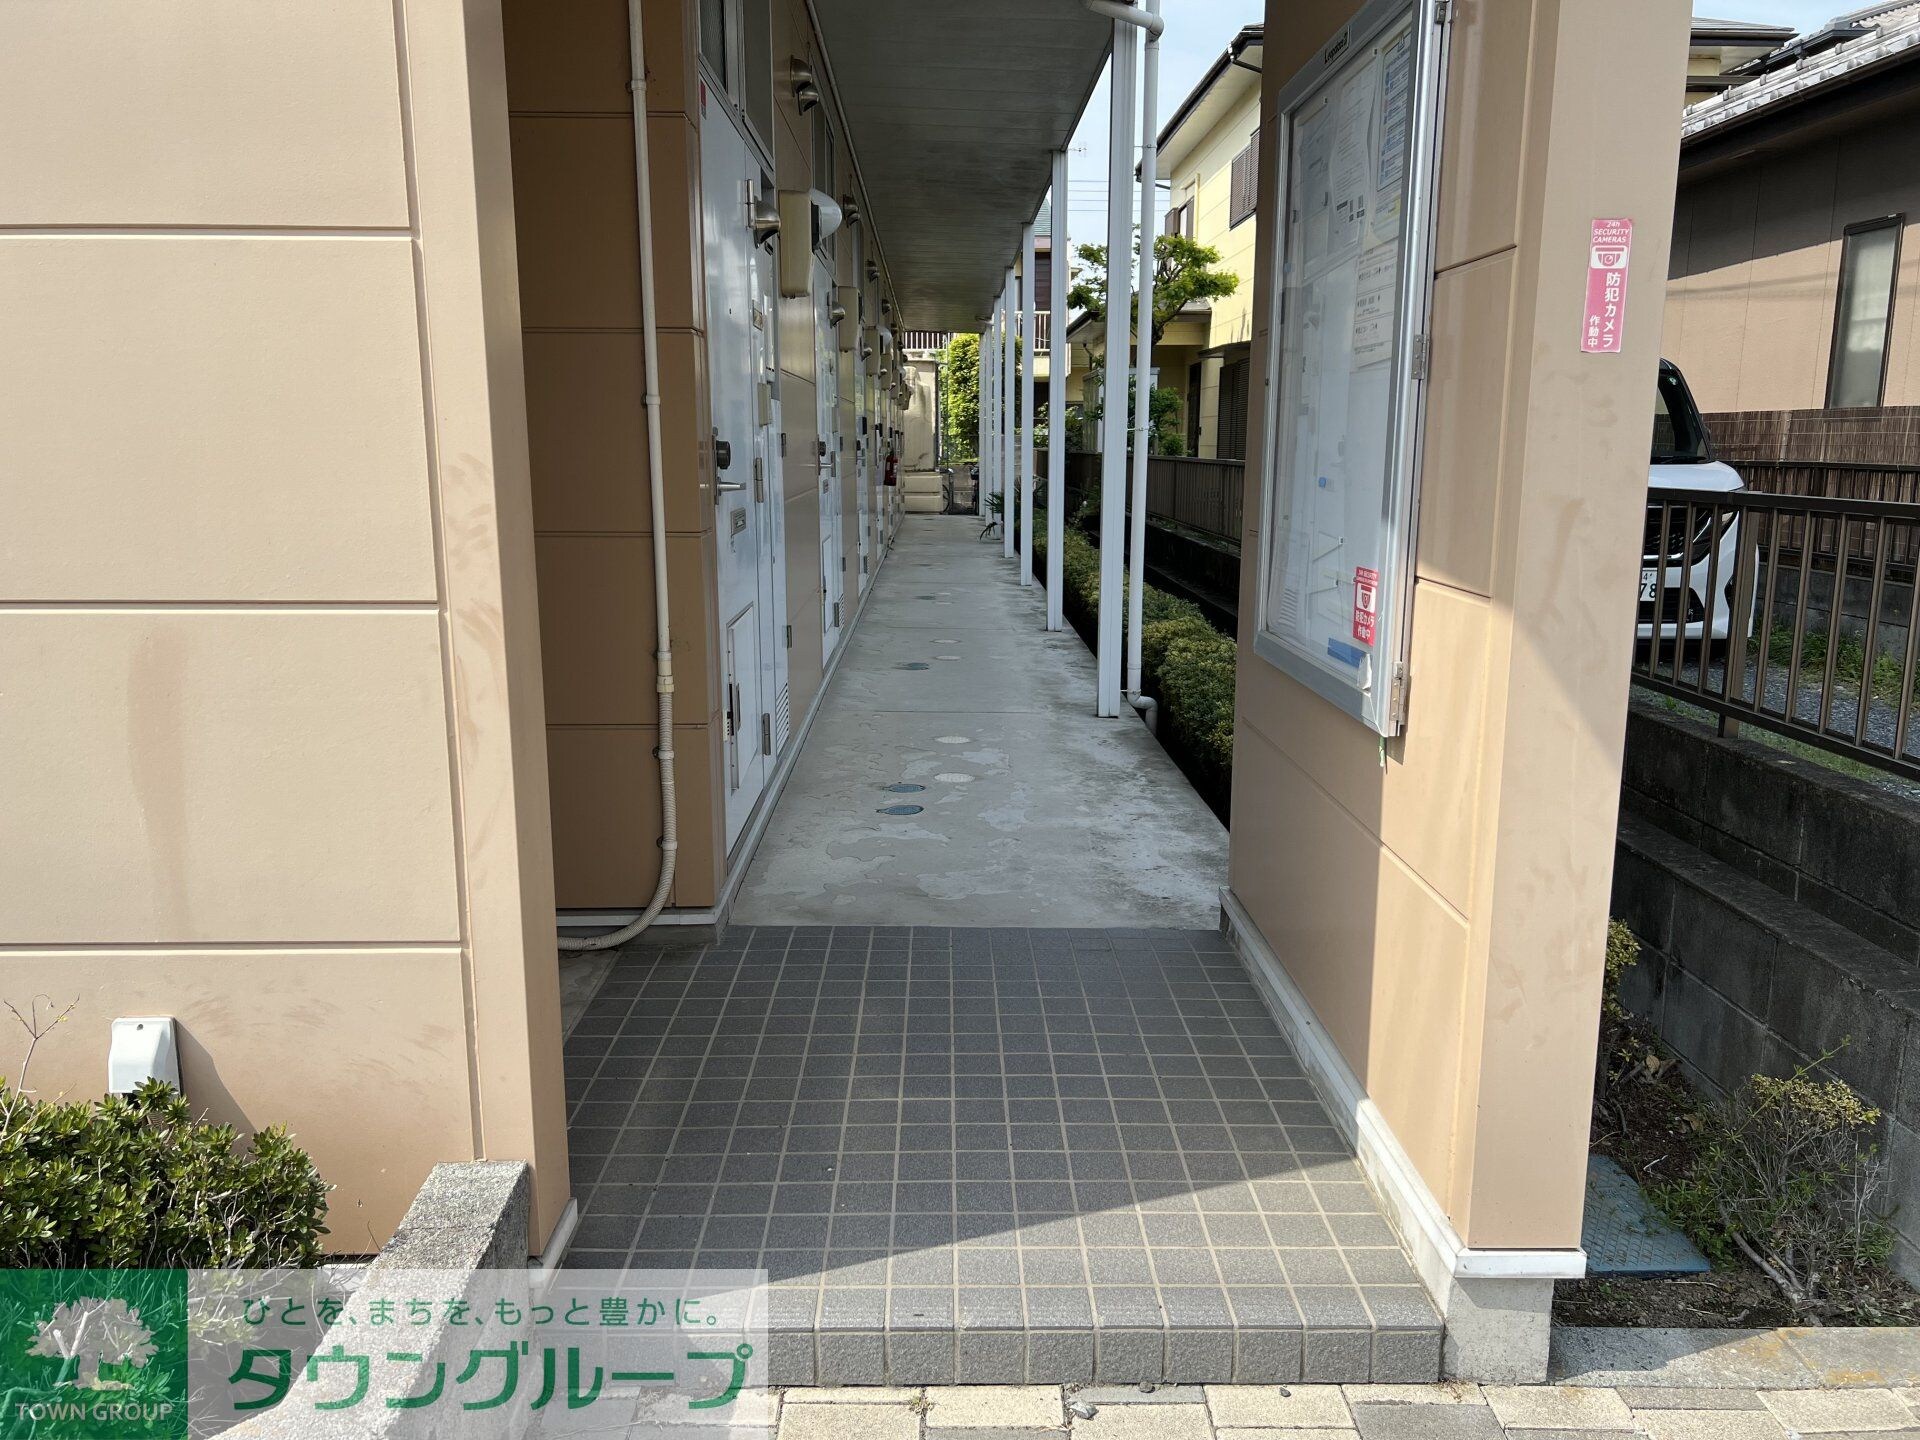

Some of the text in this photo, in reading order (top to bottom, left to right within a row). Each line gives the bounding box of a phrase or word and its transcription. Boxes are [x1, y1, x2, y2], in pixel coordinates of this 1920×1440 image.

[1593, 228, 1629, 236] SECURITY
[1602, 272, 1621, 348] 防犯カメラ
[1587, 315, 1600, 348] 作動中
